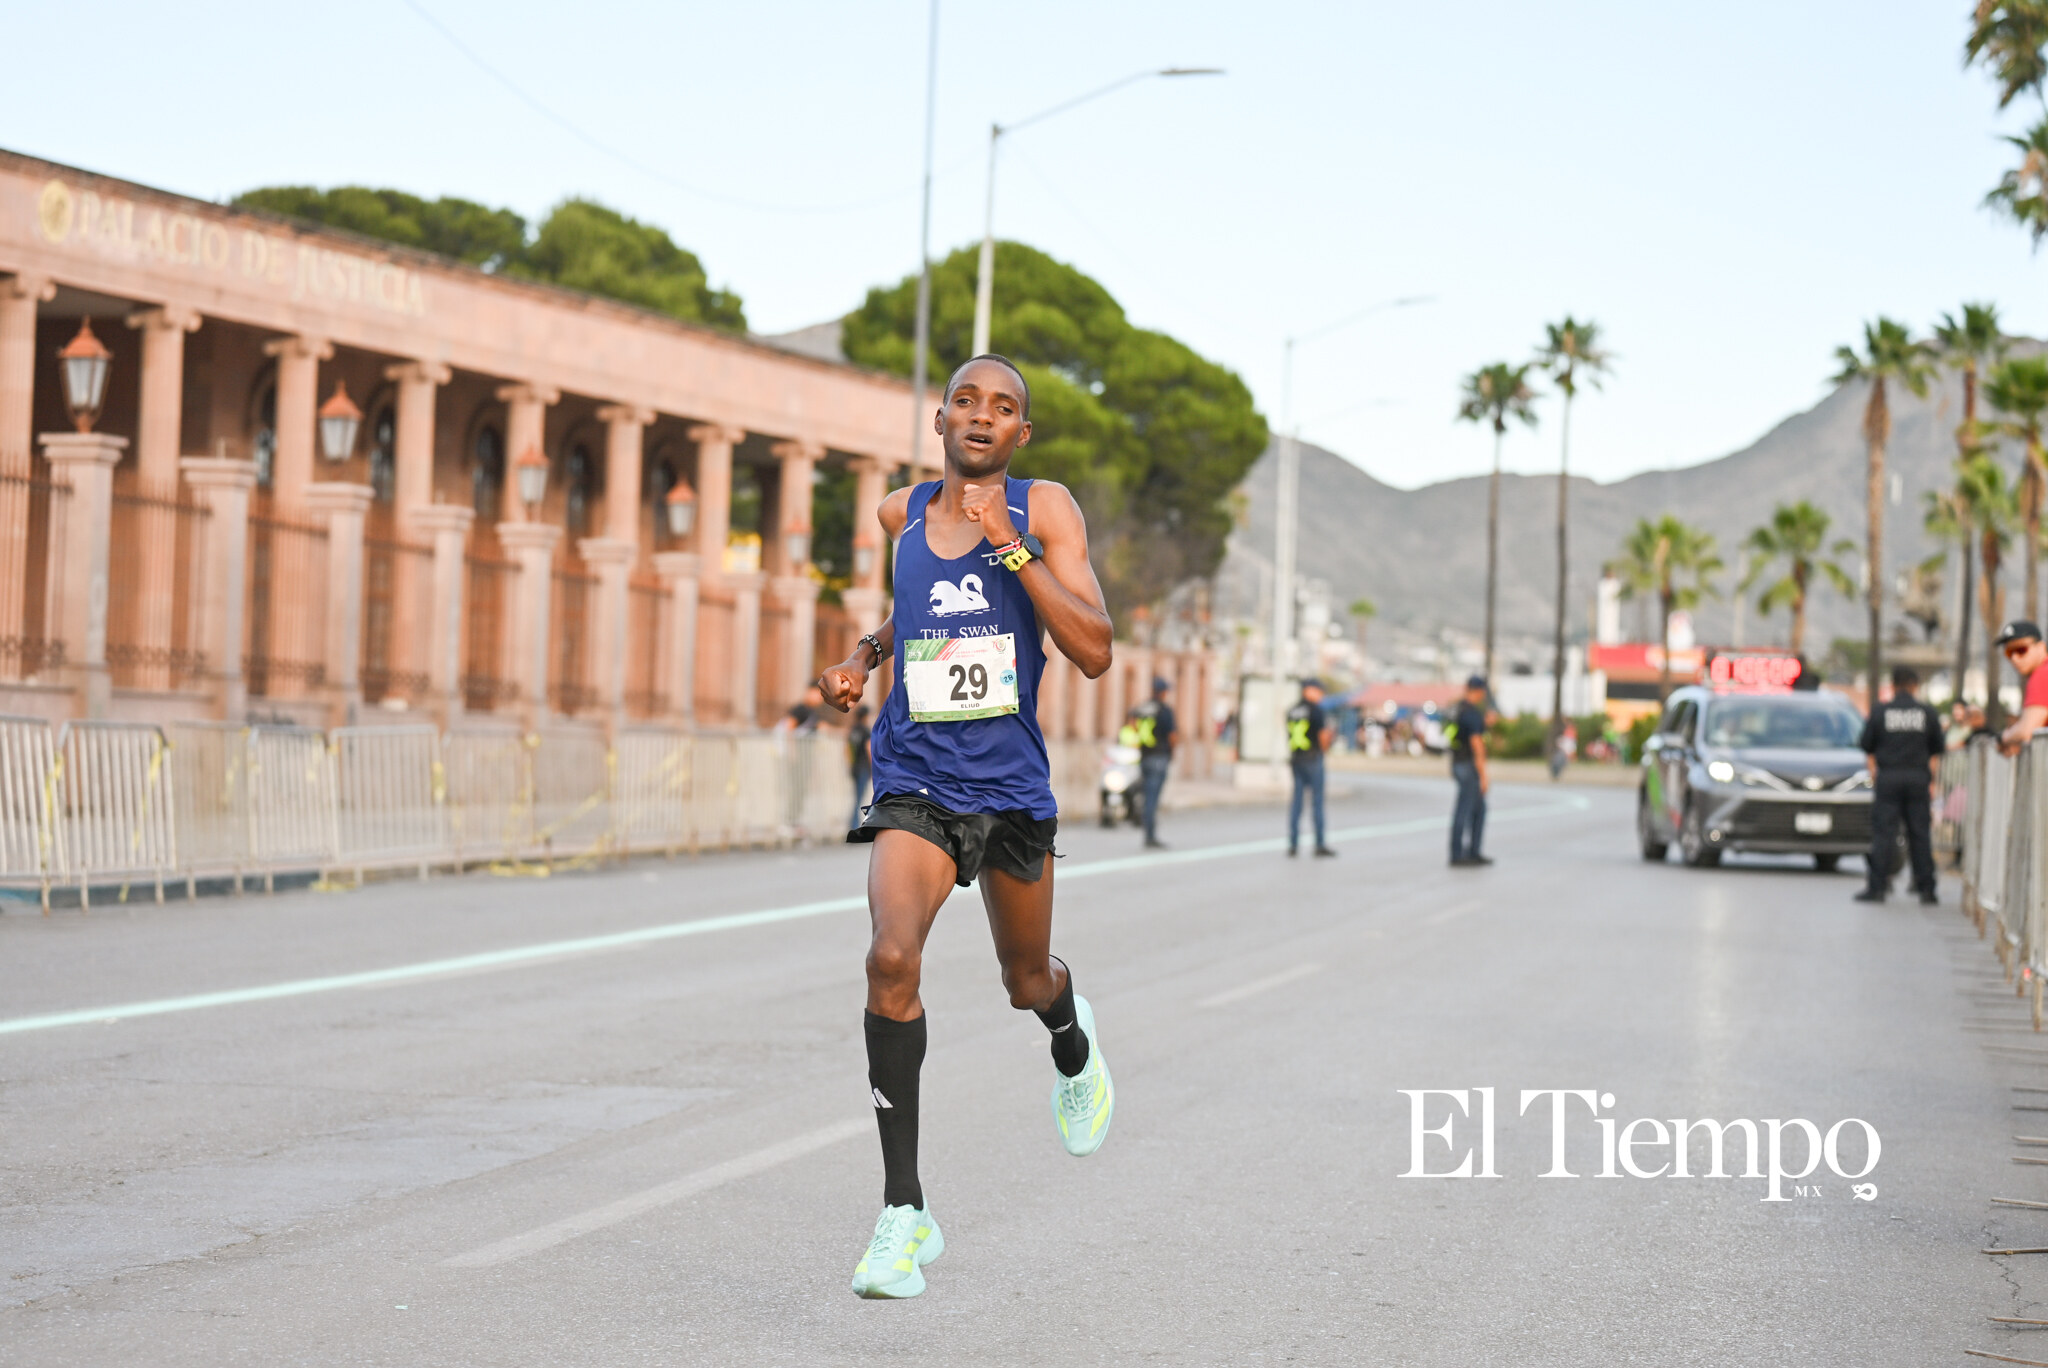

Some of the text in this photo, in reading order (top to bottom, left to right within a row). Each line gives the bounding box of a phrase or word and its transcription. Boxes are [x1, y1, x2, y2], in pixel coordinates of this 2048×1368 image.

[78, 190, 425, 317] PALACIO DE JUSTICIA
[920, 624, 999, 640] THE SWAN
[949, 663, 988, 701] 29
